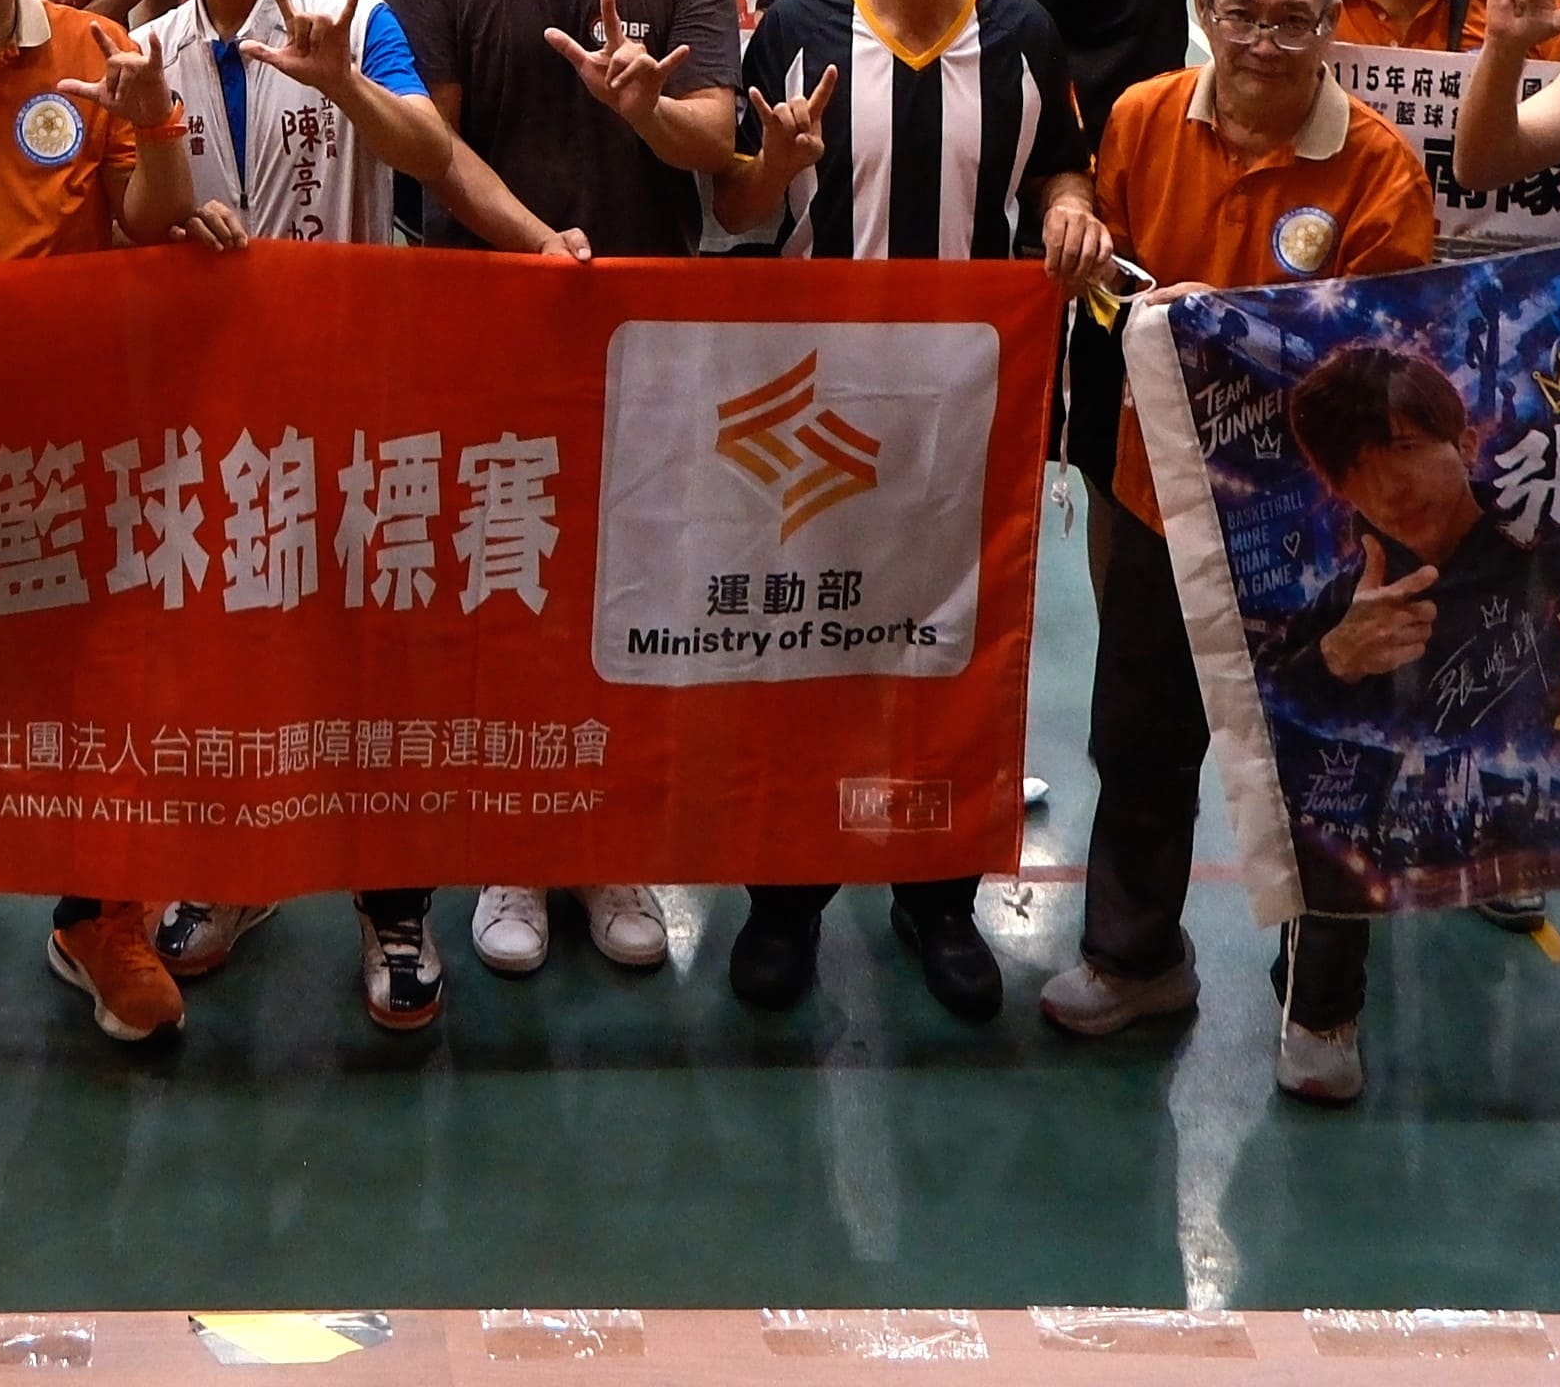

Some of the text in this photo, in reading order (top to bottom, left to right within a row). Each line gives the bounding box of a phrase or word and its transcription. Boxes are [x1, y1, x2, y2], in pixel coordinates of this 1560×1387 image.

[186, 115, 206, 156] 秘書
[1196, 374, 1251, 414] TEAM
[706, 569, 863, 618] 運動部
[628, 618, 938, 658] Ministry of Sports
[91, 797, 226, 826] ATHLETIC
[235, 791, 412, 828] ASSOCIATION
[421, 791, 456, 815] OF
[466, 789, 521, 815] THE
[532, 789, 605, 815] DEAF
